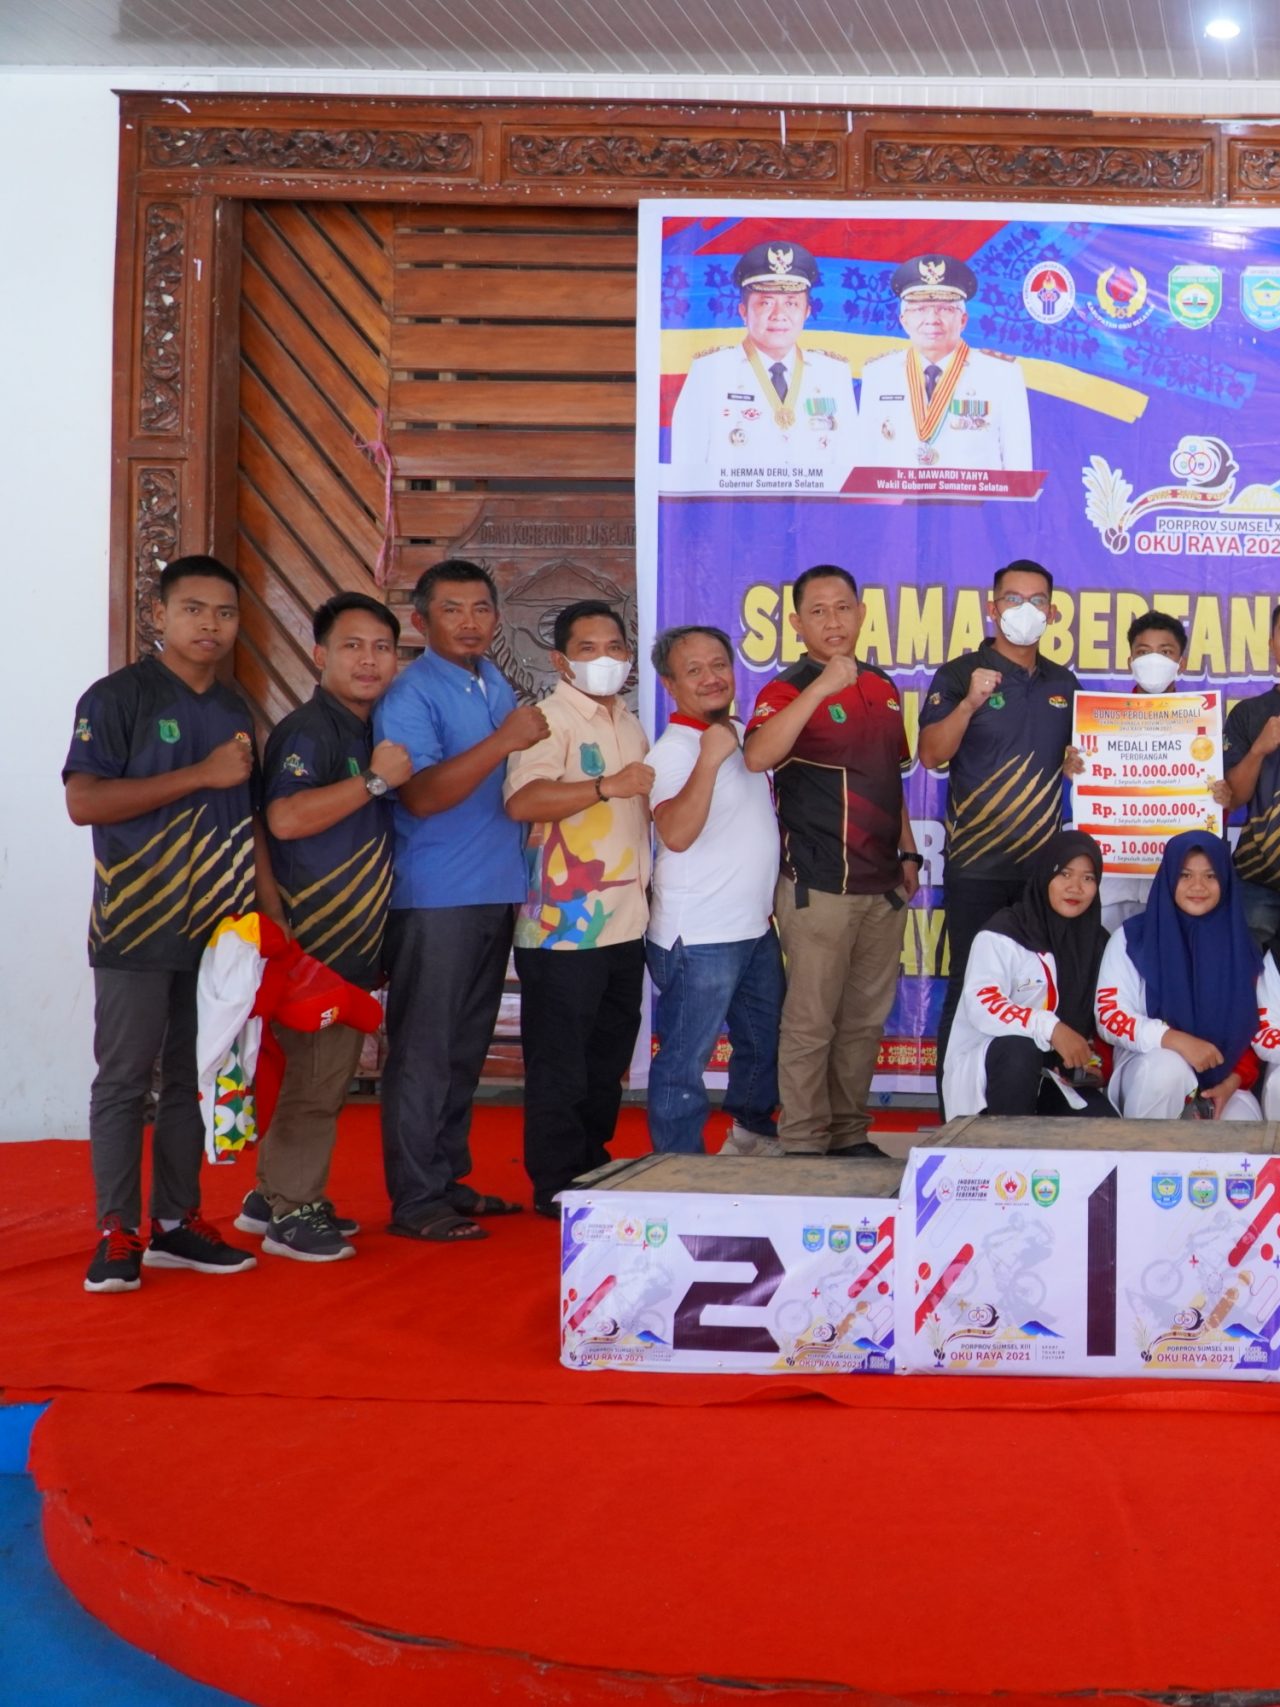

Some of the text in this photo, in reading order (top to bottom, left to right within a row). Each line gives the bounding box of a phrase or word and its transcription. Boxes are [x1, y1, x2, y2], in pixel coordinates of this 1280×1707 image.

[720, 468, 728, 477] H.
[731, 468, 764, 477] HERMAN
[767, 468, 790, 478] DERU,
[897, 470, 989, 481] Ir. H. MAWARDI YAHYA
[719, 479, 824, 488] Gubernur Sumatera Selatan
[877, 480, 1008, 492] Wakil Gubernur Sumatera Selatan
[1158, 519, 1217, 532] PORPROV
[1220, 521, 1272, 533] SUMSEL
[1137, 534, 1181, 552] OKU
[1187, 535, 1241, 554] RAYA
[1094, 709, 1200, 720] BONUS PEROLEHAN MEDALI
[1107, 740, 1182, 752] MEDALI EMAS
[1120, 753, 1168, 761] PERORANGAN
[1092, 763, 1205, 779] Rp. 10.000.000,-
[1092, 803, 1205, 818] Rp. 10.000.000,-
[976, 986, 1032, 1028] MUBA
[1098, 987, 1136, 1041] MUBA
[1087, 1164, 1118, 1357] 1
[673, 1234, 786, 1353] 2
[581, 1354, 599, 1362] OKU
[601, 1354, 623, 1362] RAYA
[951, 1352, 1030, 1361] OKU RAYA 2021
[1157, 1354, 1234, 1362] OKU RAYA 2021
[799, 1359, 818, 1368] OKU
[819, 1360, 841, 1368] RAYA
[842, 1360, 862, 1369] 2021
